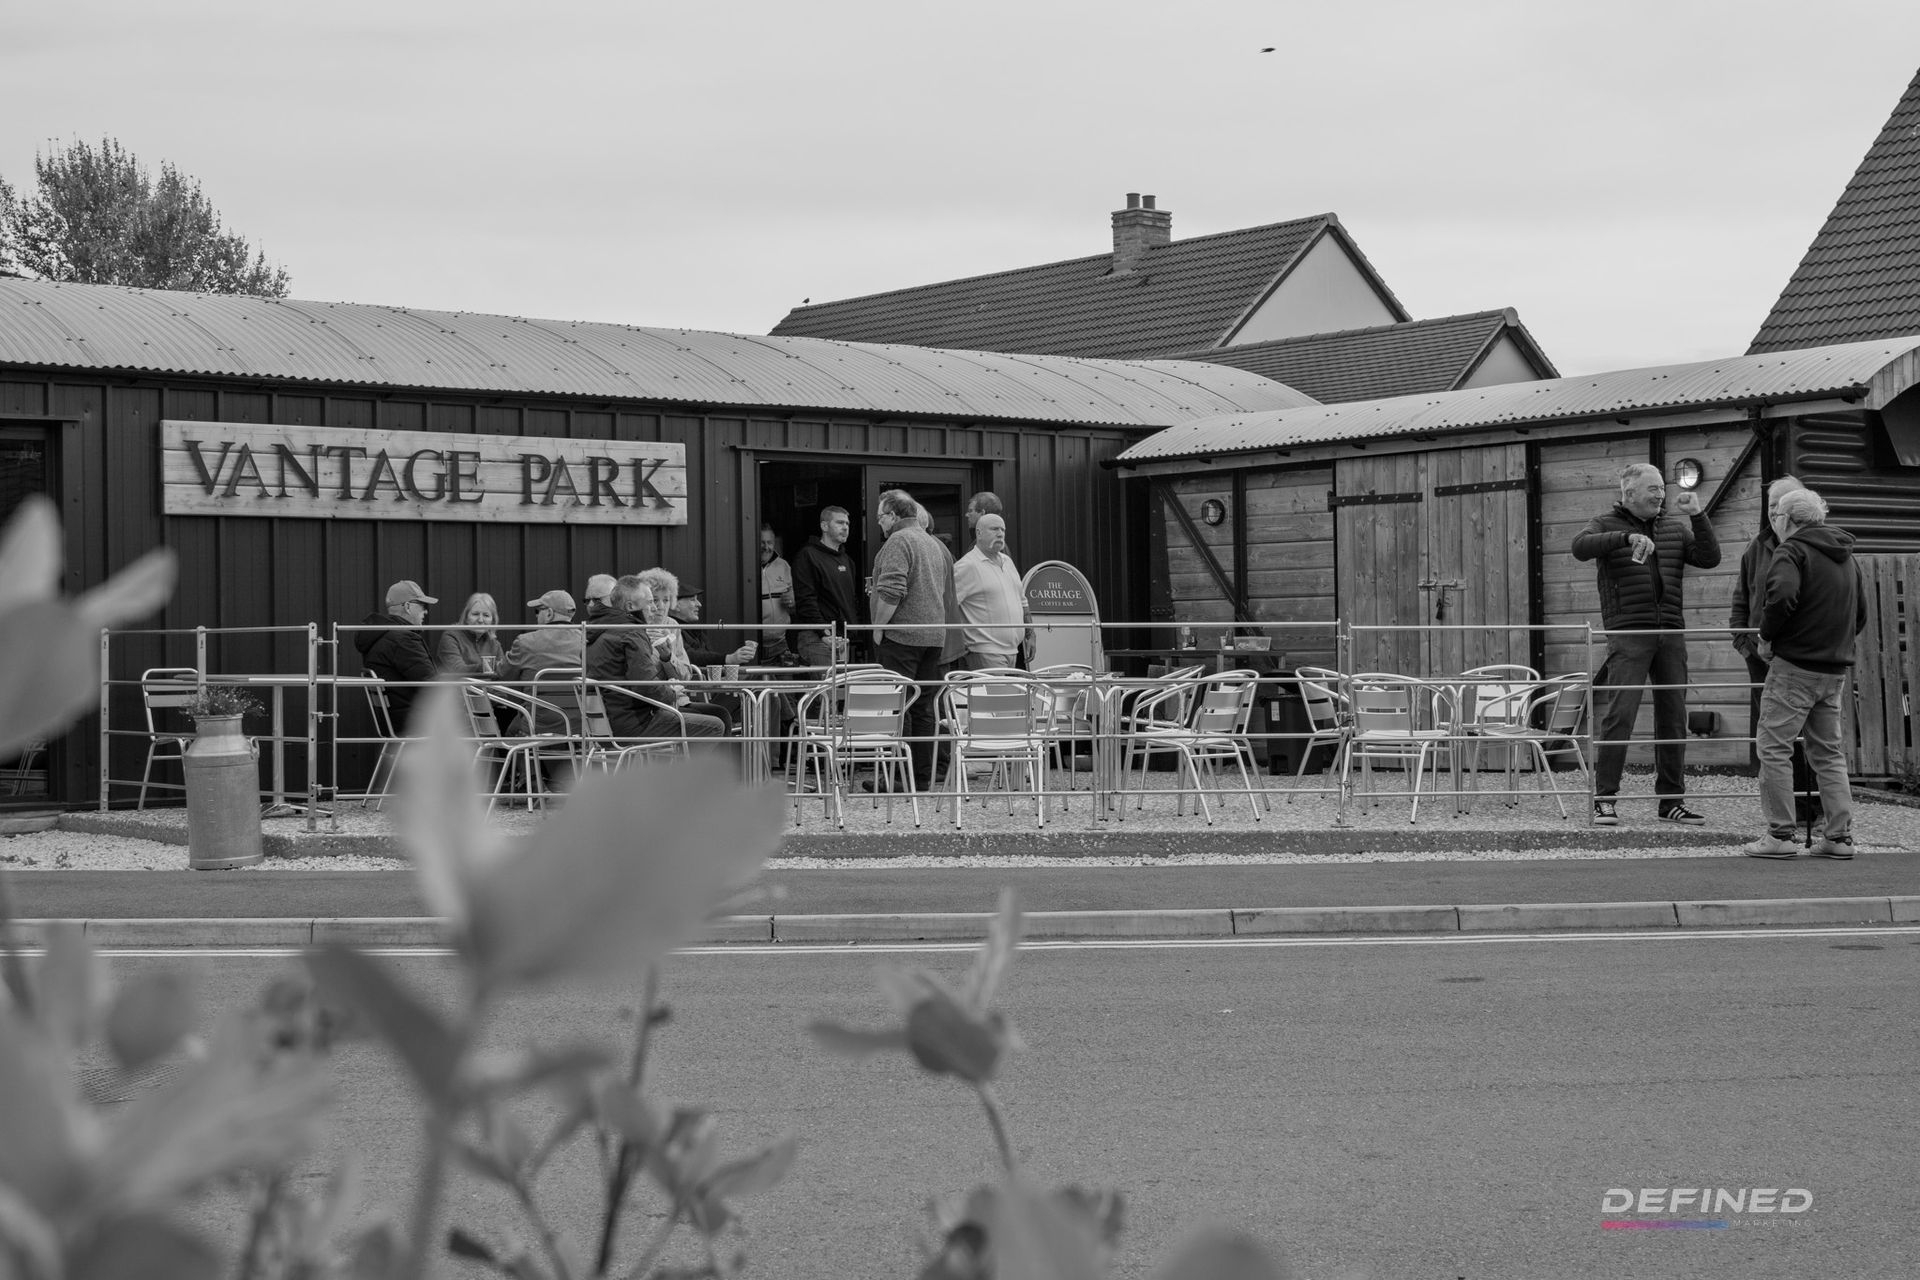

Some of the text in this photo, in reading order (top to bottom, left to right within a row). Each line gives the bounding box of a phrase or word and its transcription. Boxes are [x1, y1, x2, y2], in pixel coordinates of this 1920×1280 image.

[182, 439, 676, 509] VANTAGE PARK
[1048, 581, 1063, 589] THE
[1029, 589, 1082, 599] CARRIAGE
